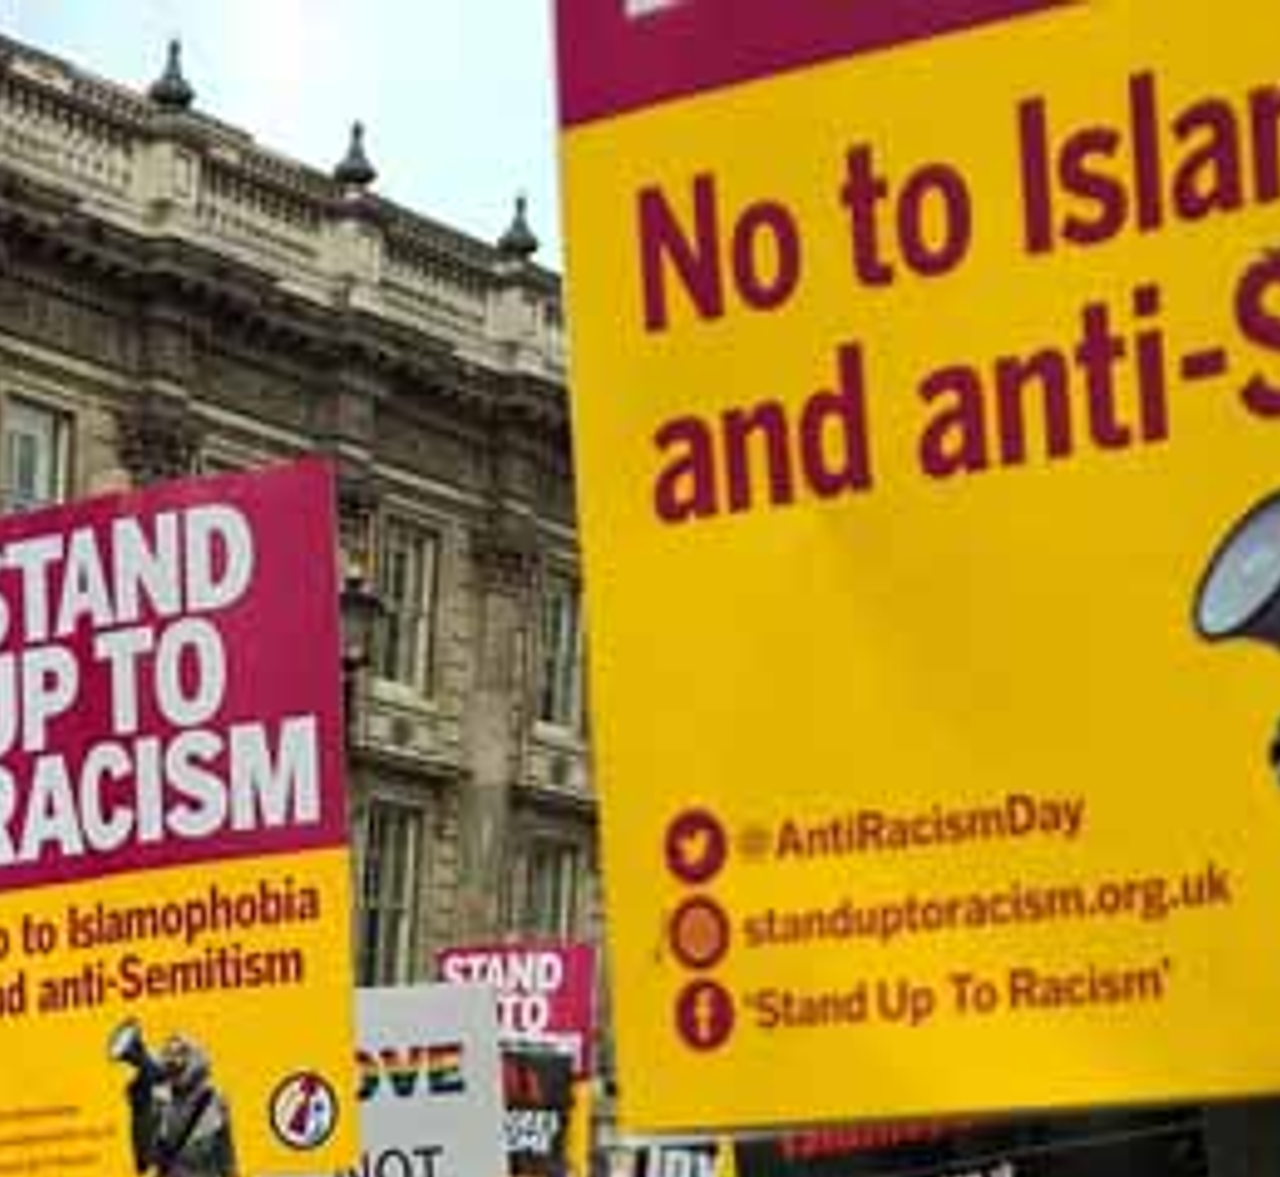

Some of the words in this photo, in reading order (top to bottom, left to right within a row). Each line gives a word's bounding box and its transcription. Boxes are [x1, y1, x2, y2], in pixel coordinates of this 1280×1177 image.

[635, 173, 801, 333] No
[840, 143, 973, 286] to
[653, 342, 873, 525] and
[93, 616, 225, 735] TO
[22, 914, 57, 954] to
[68, 877, 320, 949] Islamophobia
[744, 864, 1231, 945] standuptoracism.org.uk
[38, 943, 304, 1012] anti-Semitism
[443, 953, 562, 989] STAND
[878, 978, 933, 1026] Up
[949, 972, 999, 1015] To
[498, 995, 549, 1032] TO
